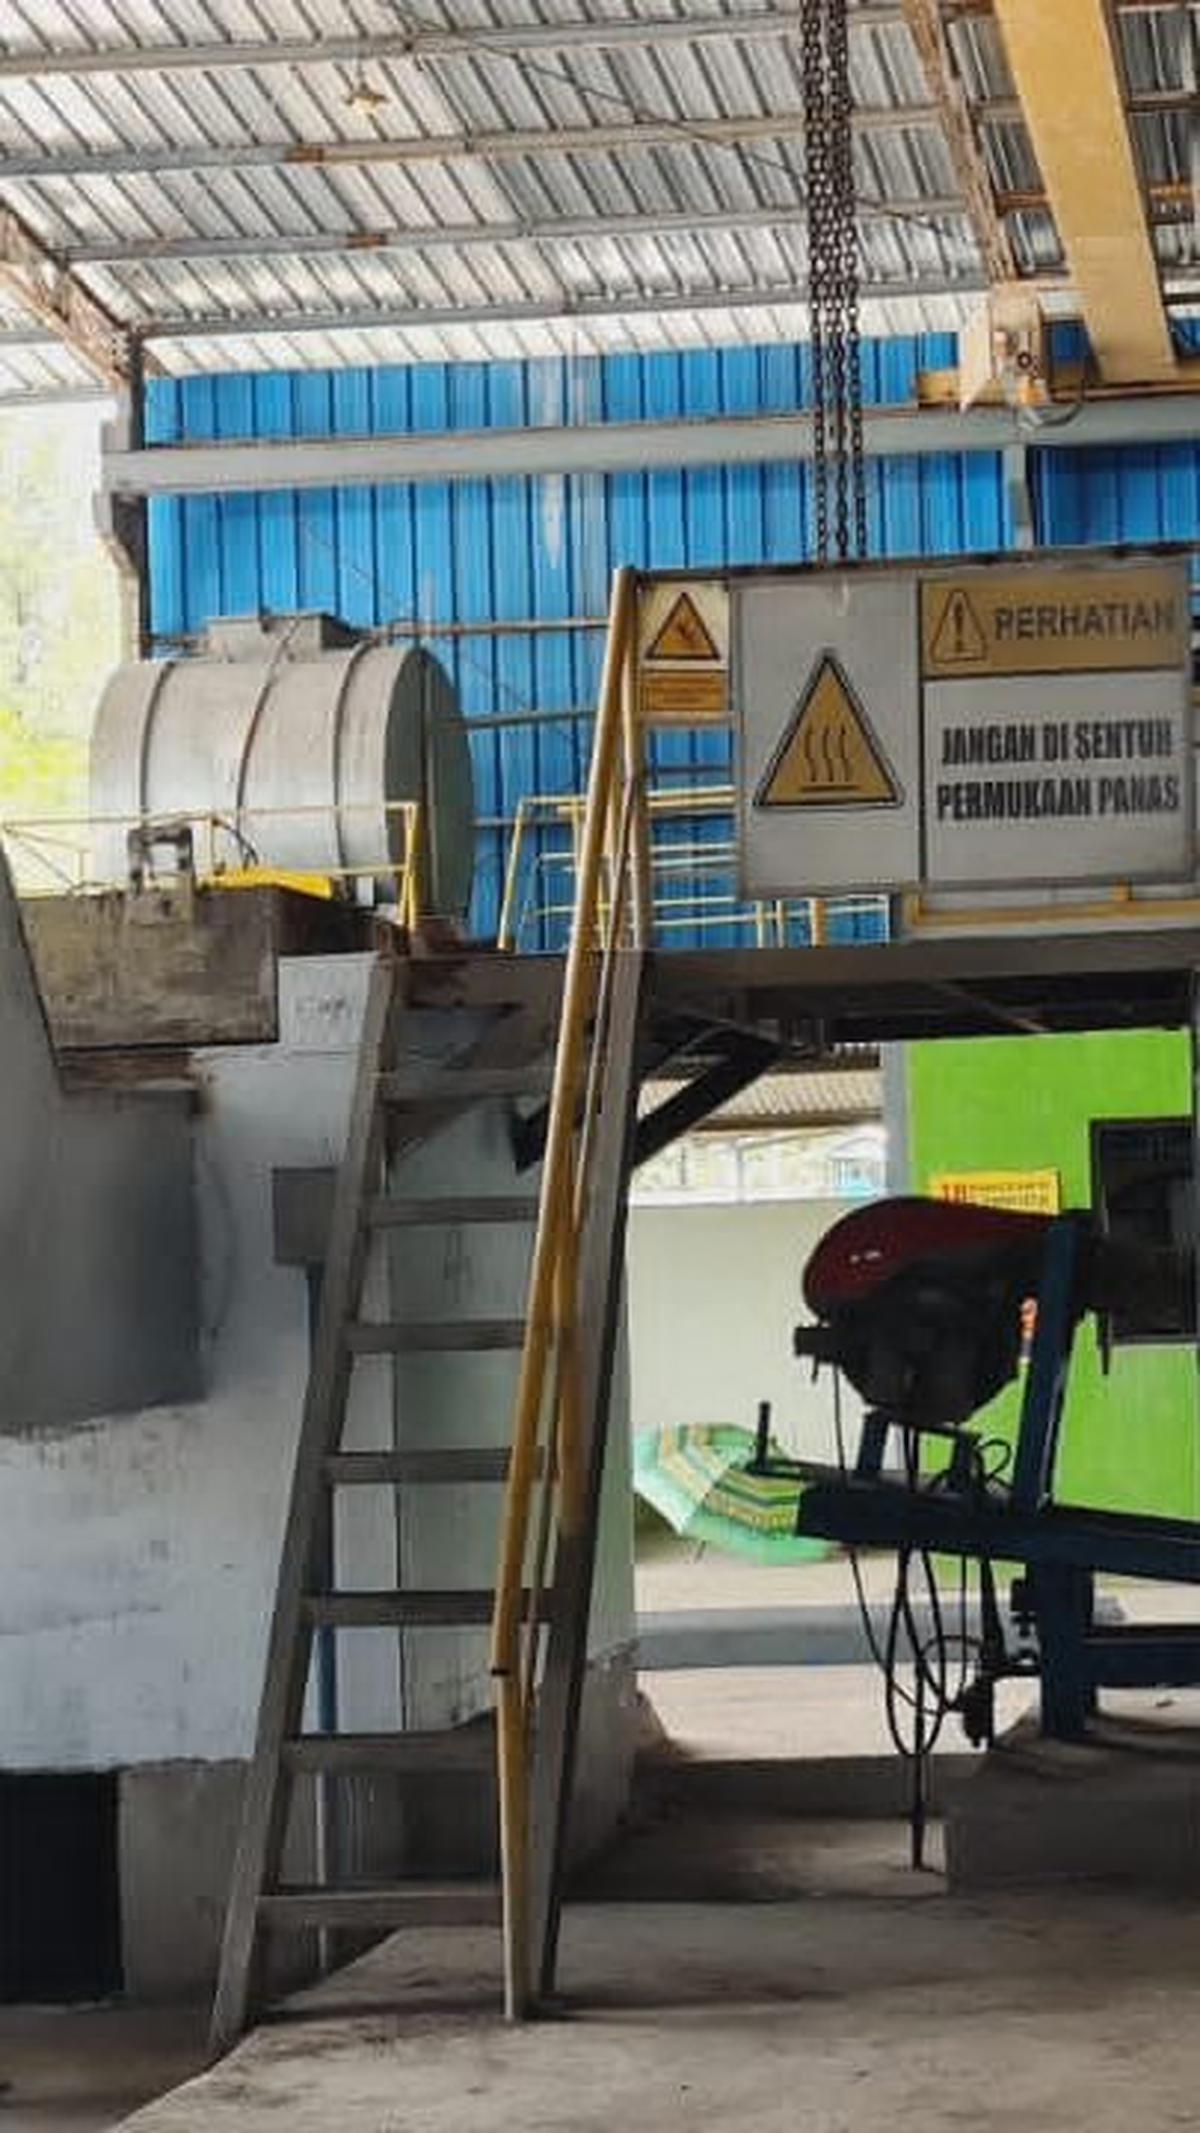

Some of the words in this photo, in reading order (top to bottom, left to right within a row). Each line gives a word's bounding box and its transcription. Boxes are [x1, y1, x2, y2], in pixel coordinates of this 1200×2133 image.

[995, 602, 1175, 641] PERHATIAN
[943, 724, 1035, 765] JANGAN
[1044, 723, 1069, 761] DI
[1074, 718, 1171, 760] SENTUH
[937, 779, 1092, 821] PERMUKAAN
[1099, 775, 1179, 814] PANAS
